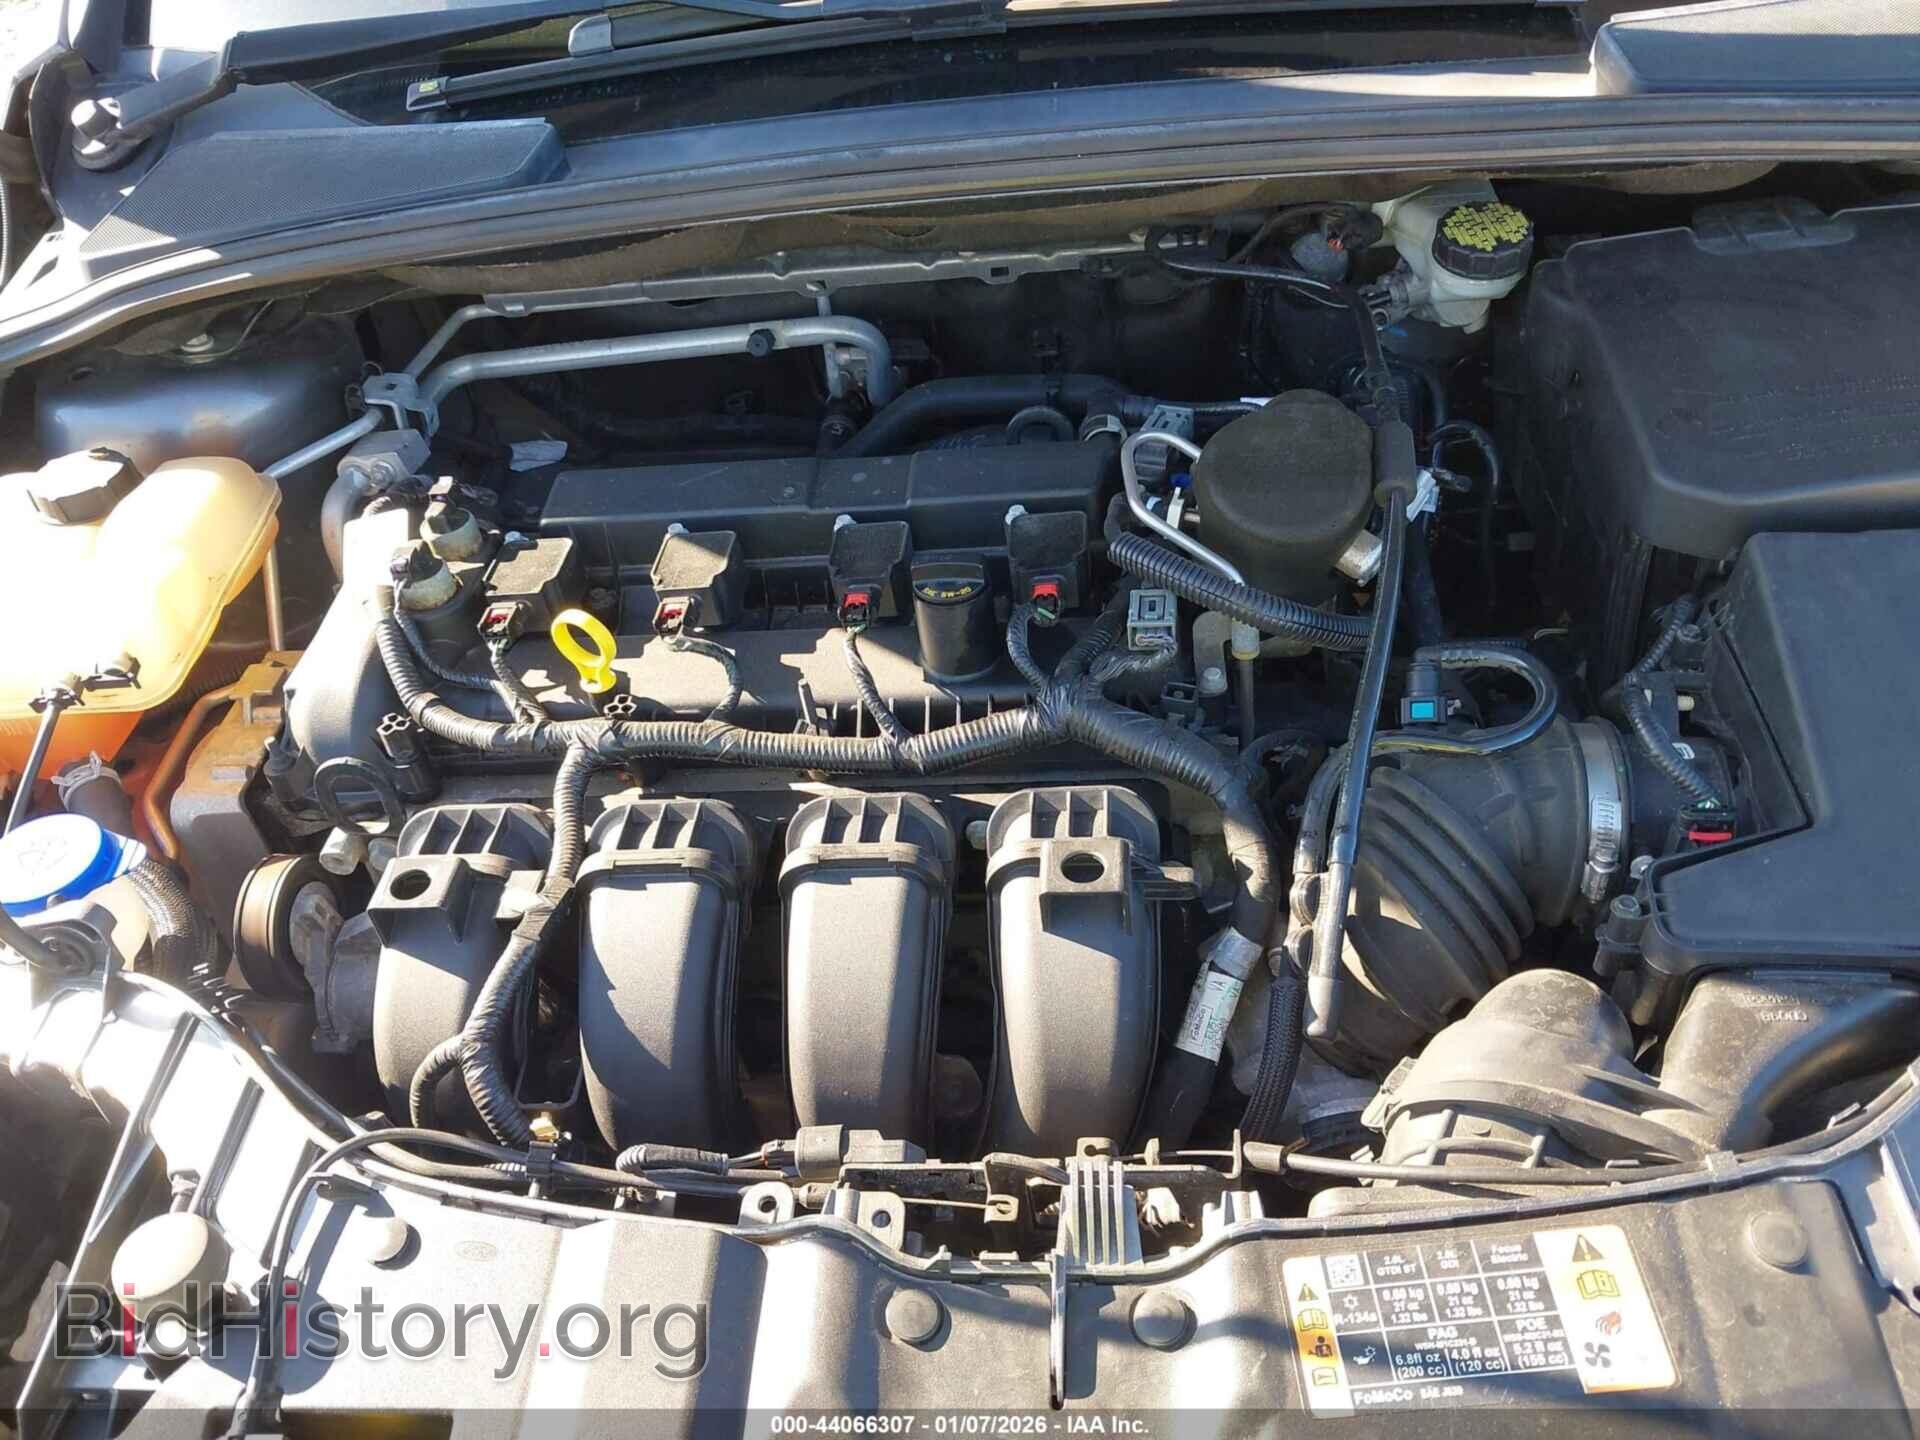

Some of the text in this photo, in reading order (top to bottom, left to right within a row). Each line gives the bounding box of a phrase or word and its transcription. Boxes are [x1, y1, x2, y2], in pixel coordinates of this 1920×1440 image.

[1516, 1317, 1548, 1332] POE
[1427, 1326, 1459, 1341] PAG
[1425, 1352, 1441, 1363] oz
[1451, 1348, 1470, 1360] 4.0
[1484, 1346, 1501, 1357] oz
[1397, 1364, 1447, 1379] (200 cc)
[1455, 1358, 1505, 1375] (120 cc)
[1354, 1388, 1413, 1405] FoMoCo
